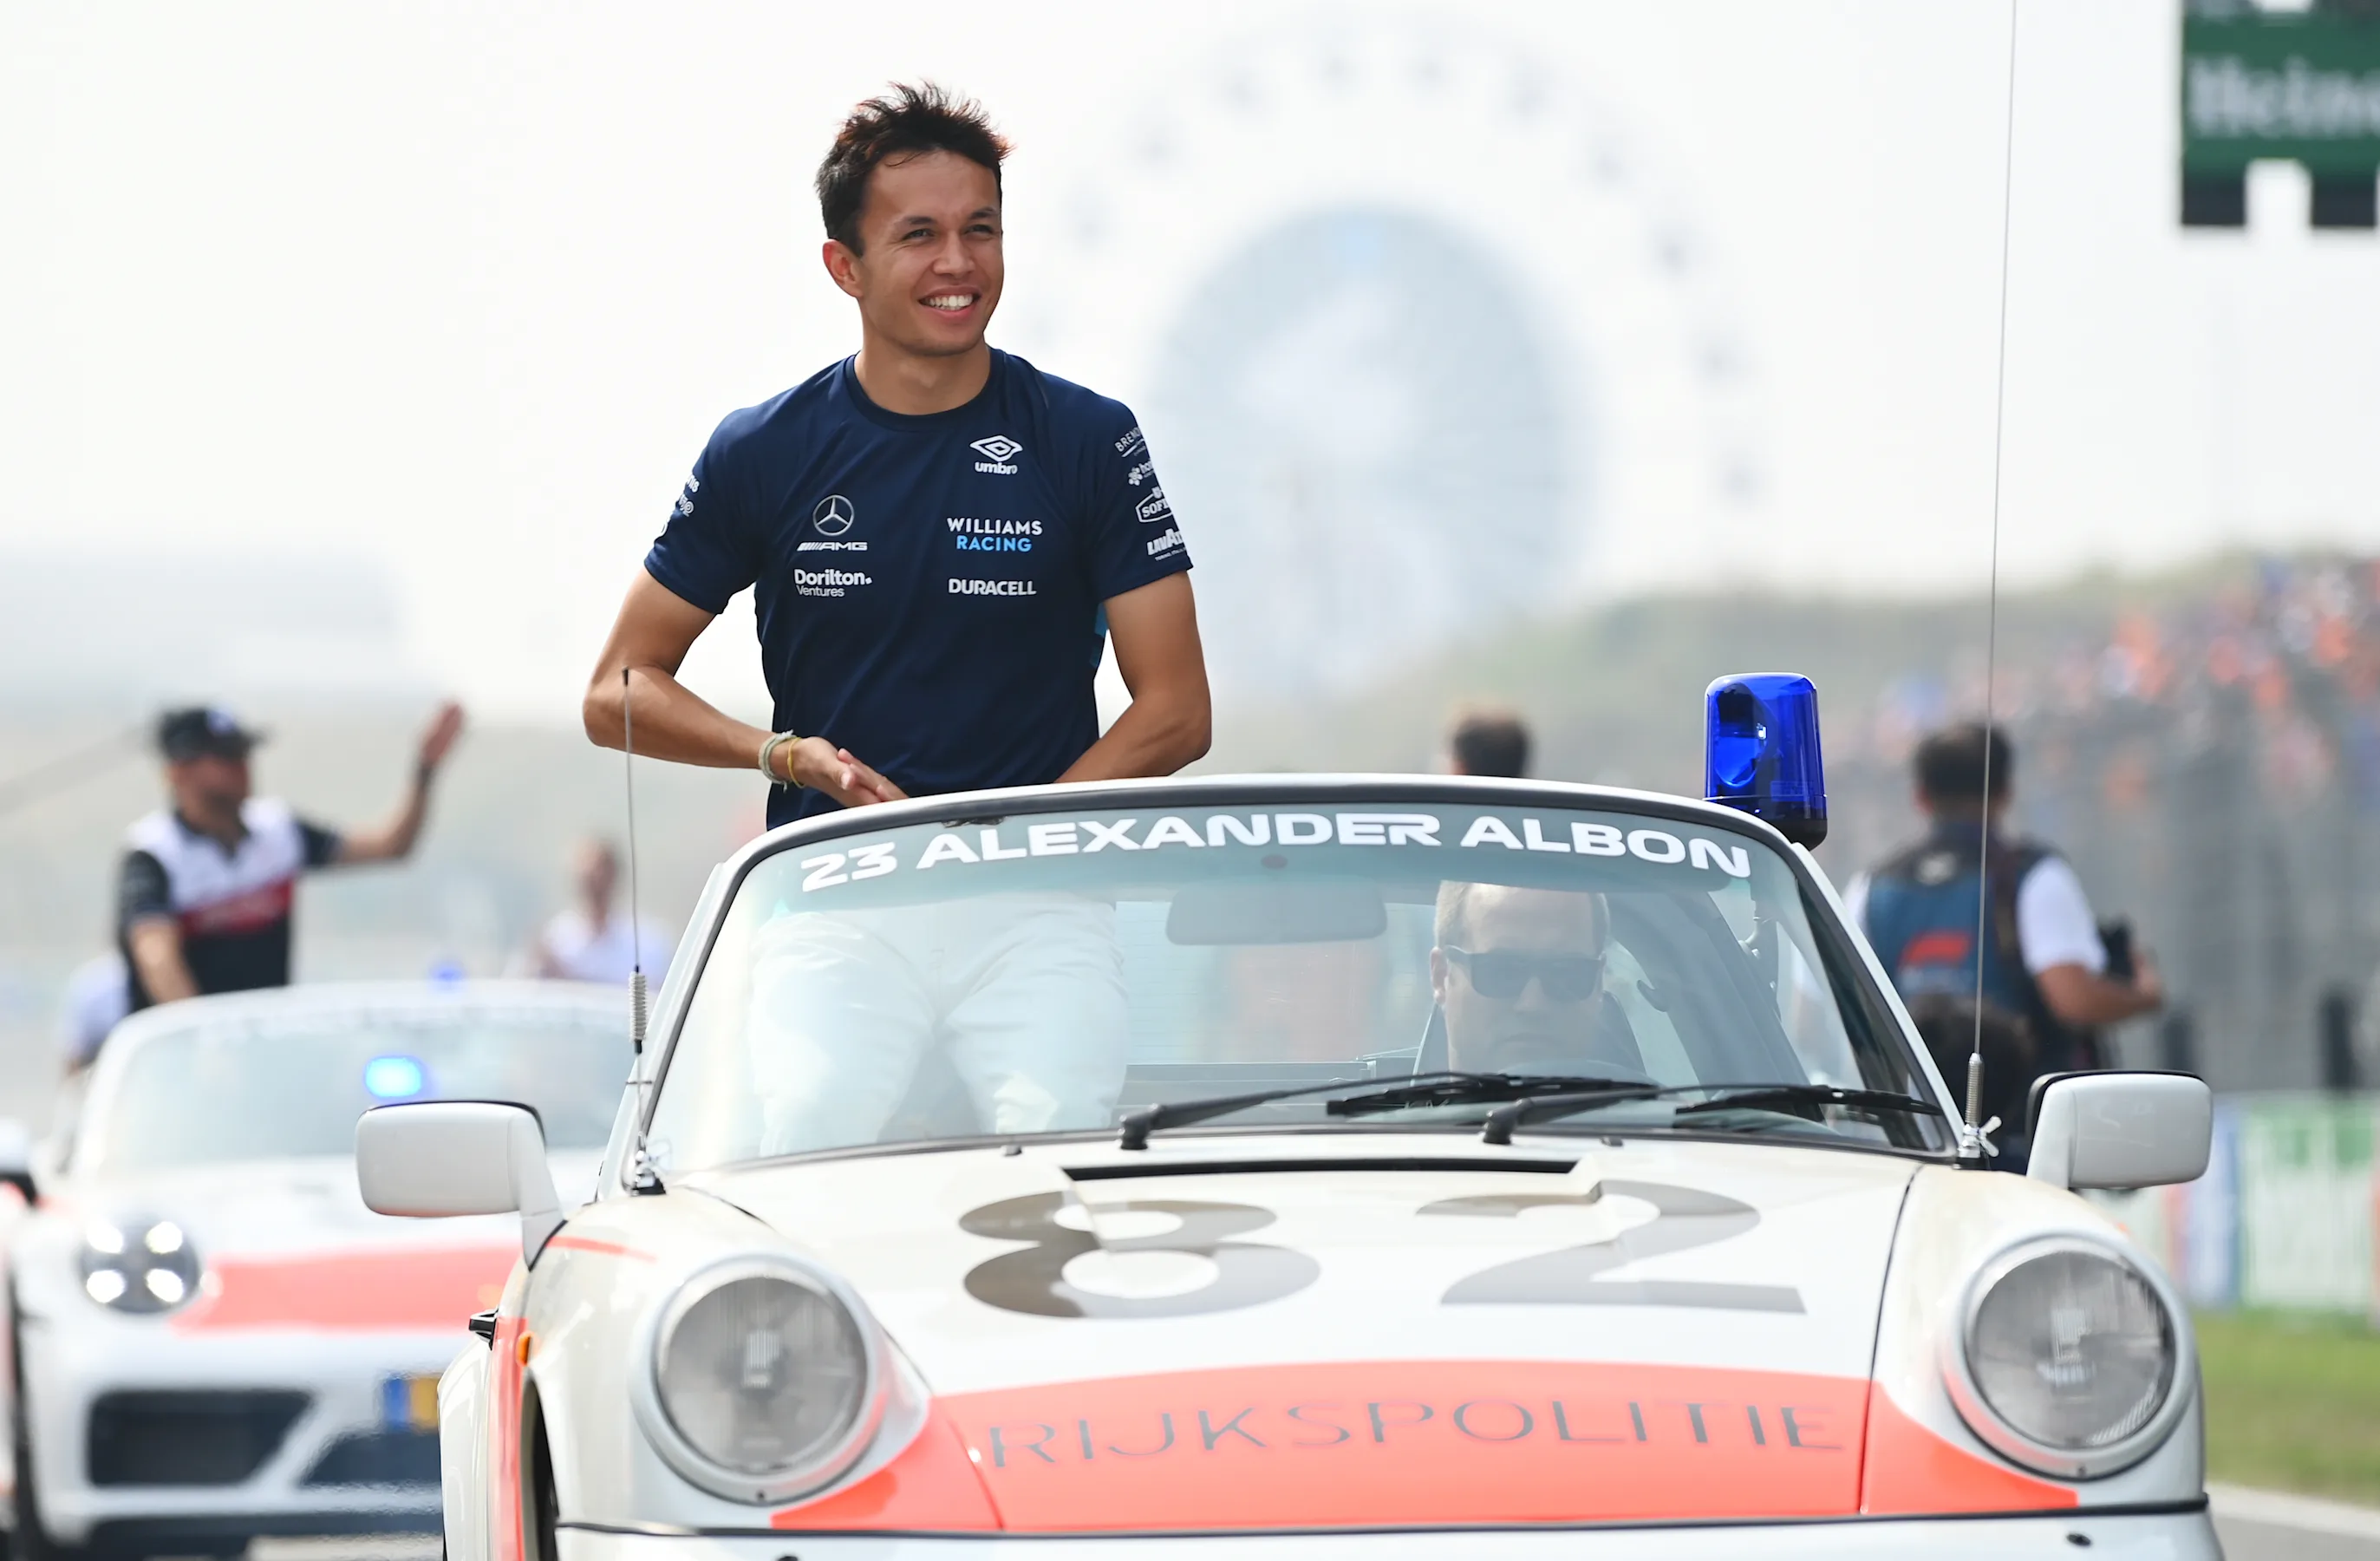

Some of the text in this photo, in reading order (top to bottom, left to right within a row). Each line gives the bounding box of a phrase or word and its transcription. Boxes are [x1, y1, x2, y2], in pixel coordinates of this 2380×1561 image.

[975, 461, 1018, 475] umbro
[947, 517, 1043, 536] WILLIAMS
[819, 542, 868, 552] AMG
[956, 535, 1032, 552] RACING
[796, 585, 844, 598] Ventures
[948, 578, 1037, 596] DURACELL
[800, 813, 1751, 892] 23 ALEXANDER ALBON
[959, 1179, 1807, 1320] 82
[988, 1399, 1843, 1468] RIJKSPOLITIE
